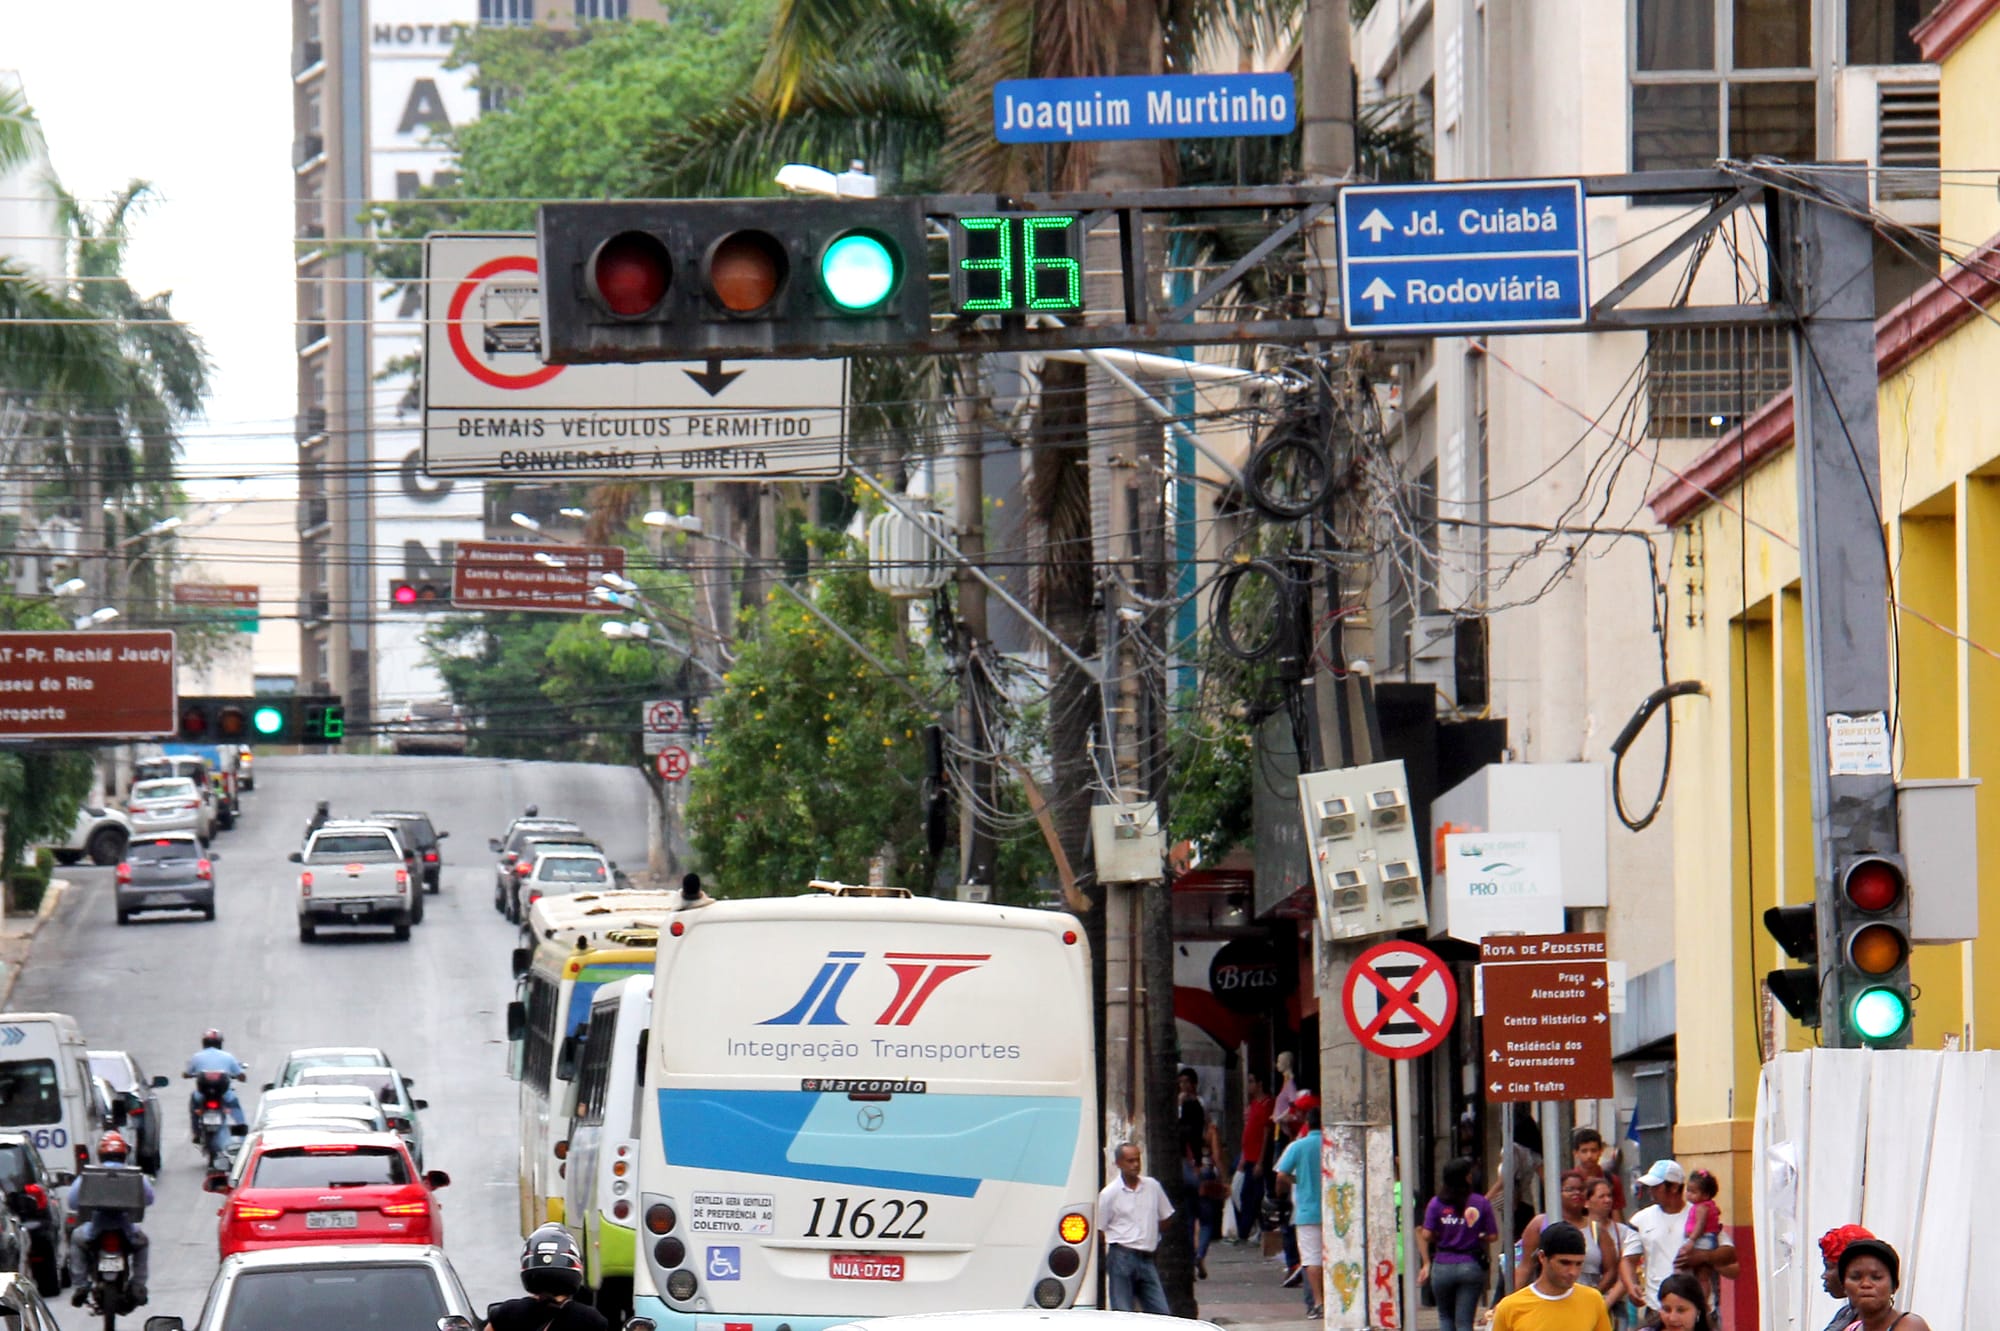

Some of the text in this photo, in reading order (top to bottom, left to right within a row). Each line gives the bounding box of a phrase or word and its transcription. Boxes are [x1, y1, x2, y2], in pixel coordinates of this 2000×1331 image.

[374, 24, 453, 43] HOTE
[1003, 87, 1287, 135] Joaquim Murtinho
[1402, 206, 1558, 236] Jd. Cuiabá
[960, 217, 1080, 310] 36
[1406, 275, 1561, 304] Rodoviária
[458, 413, 812, 437] DEMAIS VEÍCULOS PERMITIDO
[500, 446, 768, 471] CONVERSÃO À DIREITA
[54, 646, 113, 663] Rachid
[40, 676, 61, 691] do
[66, 675, 94, 691] Rio
[1469, 878, 1498, 896] PRÓ
[1482, 941, 1605, 956] ROTA DE PEDESTRE
[1558, 972, 1585, 985] Praça
[1531, 989, 1586, 999] Alencastro
[1503, 1014, 1588, 1026] Centro Histórico
[727, 1038, 1021, 1061] Integração Transportes
[1507, 1040, 1582, 1051] Residência dos
[1508, 1056, 1576, 1067] Governadores
[819, 1080, 924, 1093] Marcopolo
[1508, 1081, 1566, 1093] Cine Teatro
[762, 1211, 773, 1220] AO
[803, 1197, 928, 1239] 11622
[694, 1221, 743, 1232] COLETIVO.
